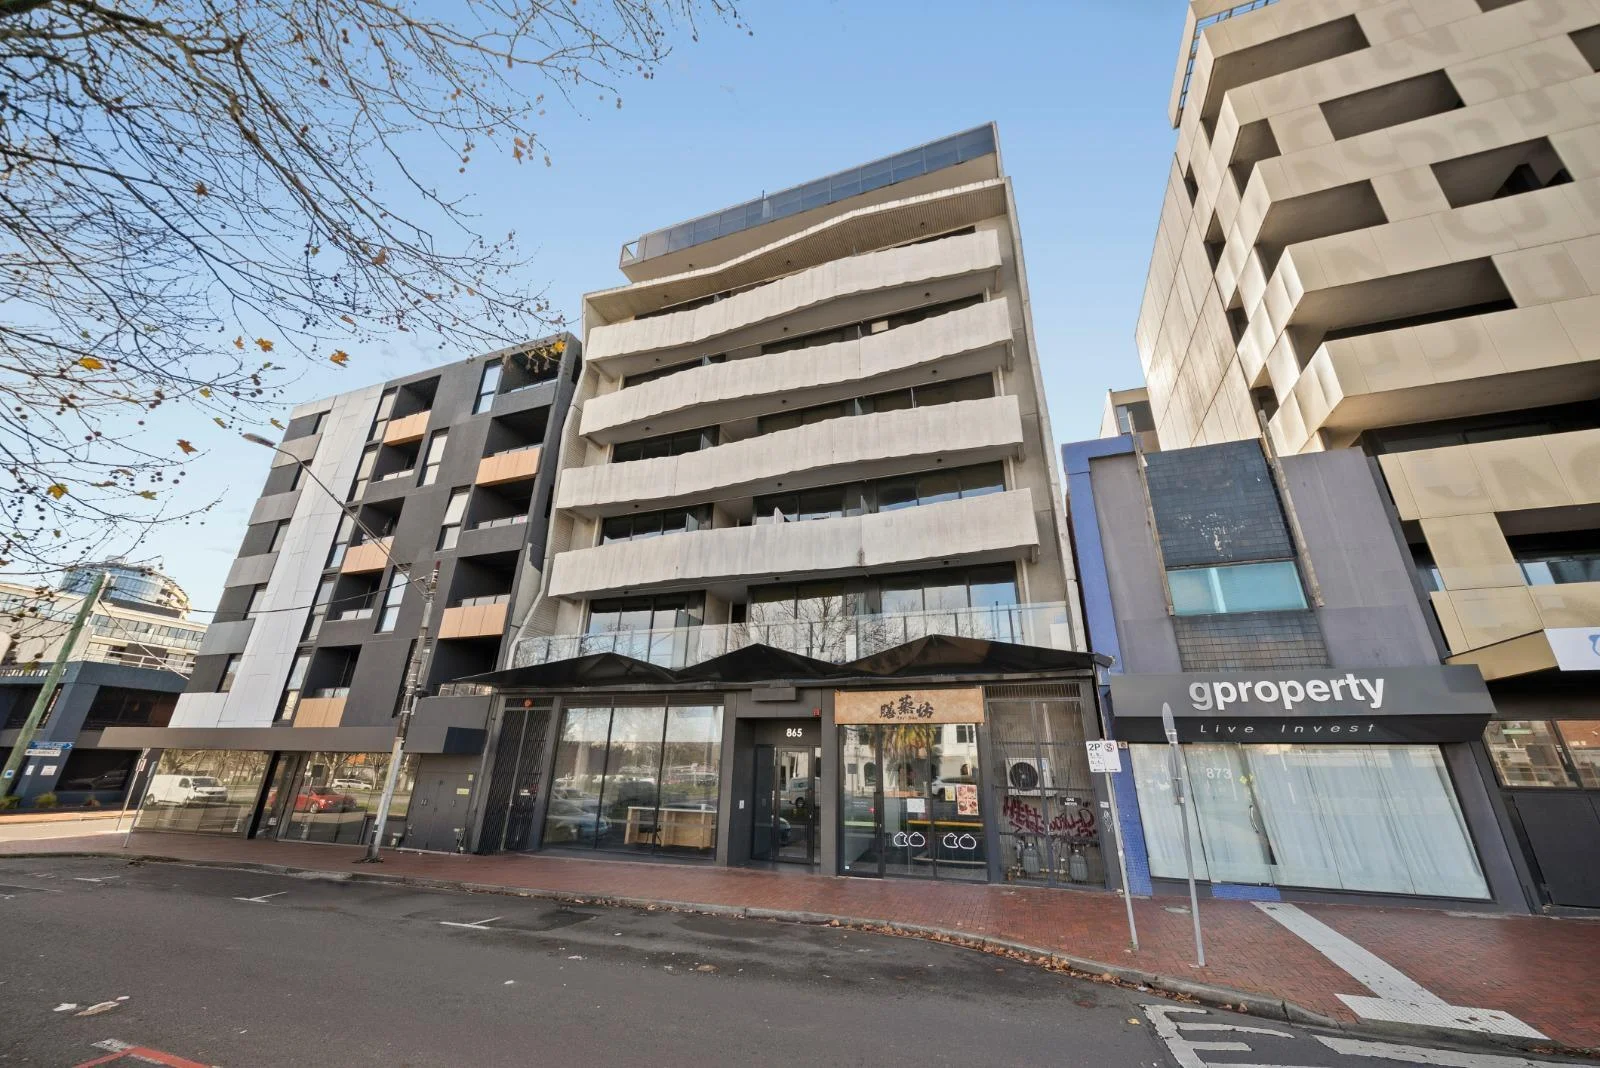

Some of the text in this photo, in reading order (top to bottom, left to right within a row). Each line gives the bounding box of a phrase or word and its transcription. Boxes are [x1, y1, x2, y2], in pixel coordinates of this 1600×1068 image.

[1188, 673, 1385, 711] gproperty
[786, 728, 803, 737] 865
[1200, 723, 1376, 733] Live Invest
[1088, 743, 1101, 751] 2P
[1206, 768, 1232, 779] 873
